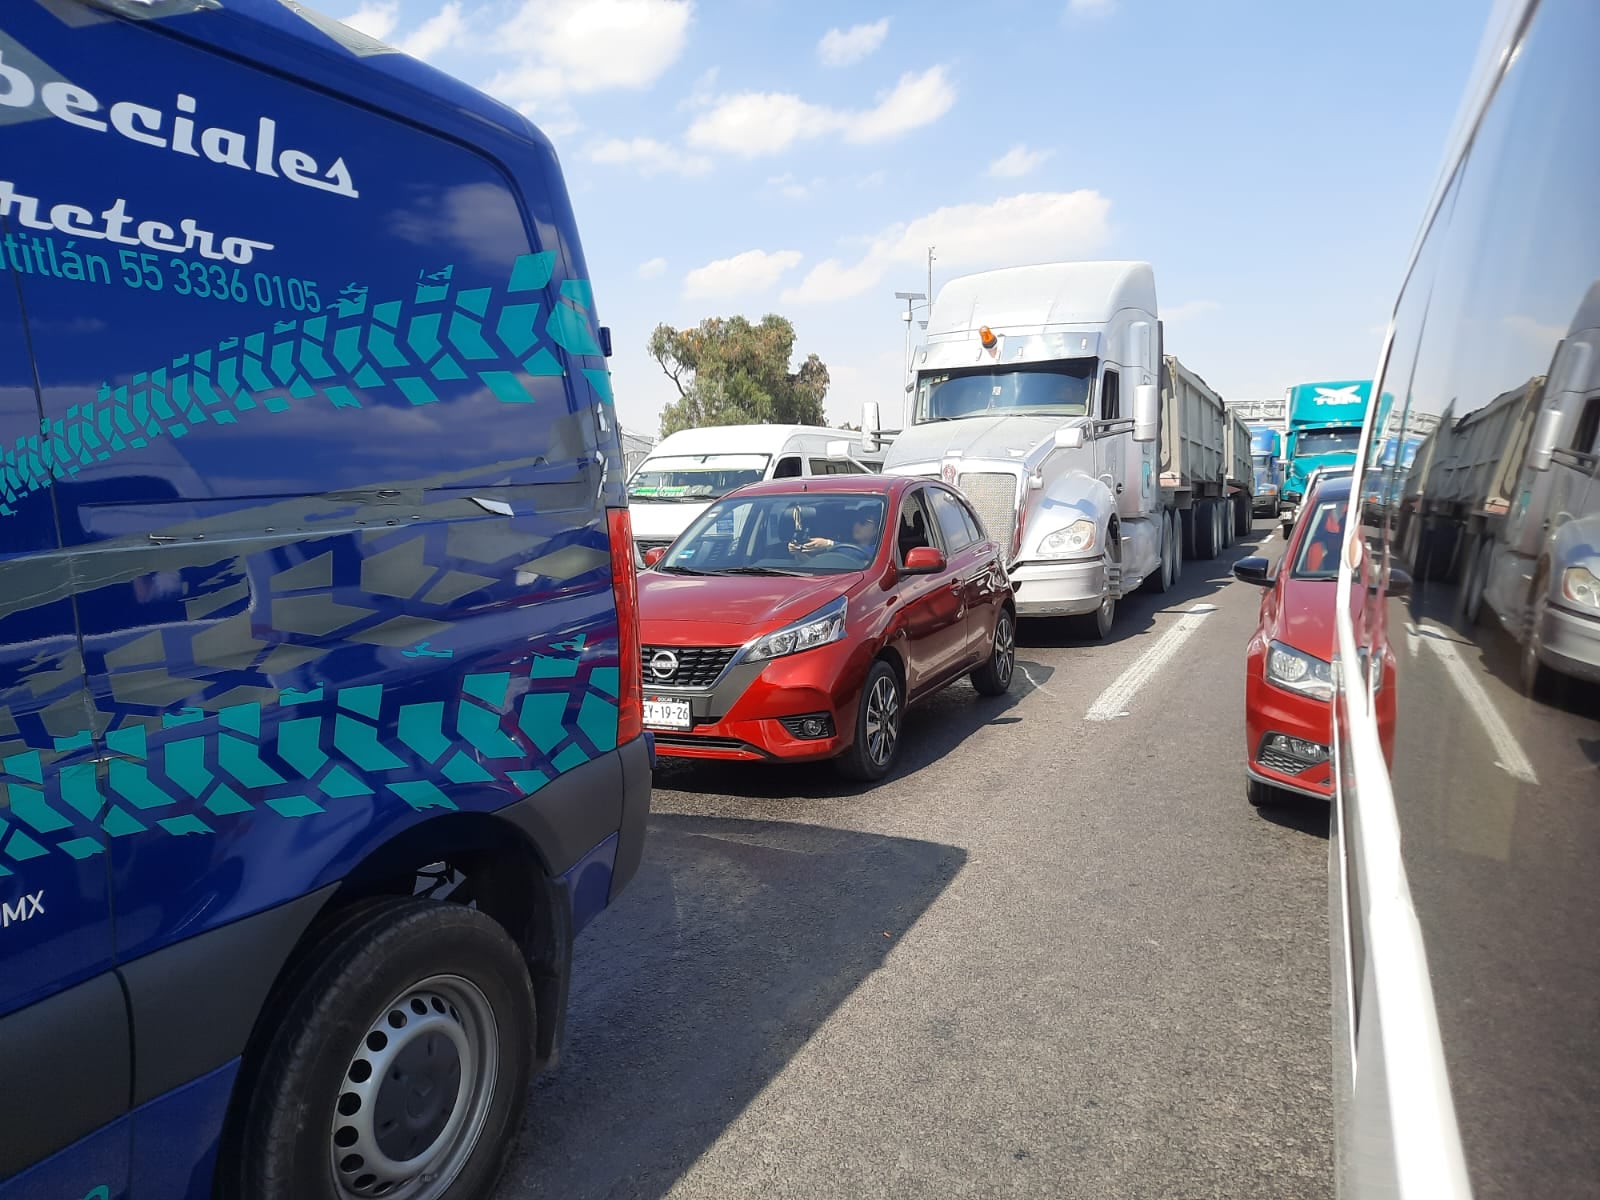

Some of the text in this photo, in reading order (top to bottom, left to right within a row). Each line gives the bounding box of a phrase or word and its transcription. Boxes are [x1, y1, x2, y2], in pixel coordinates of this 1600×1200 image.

[0, 232, 321, 313] titlán 55 3336 0105
[0, 889, 45, 928] MX
